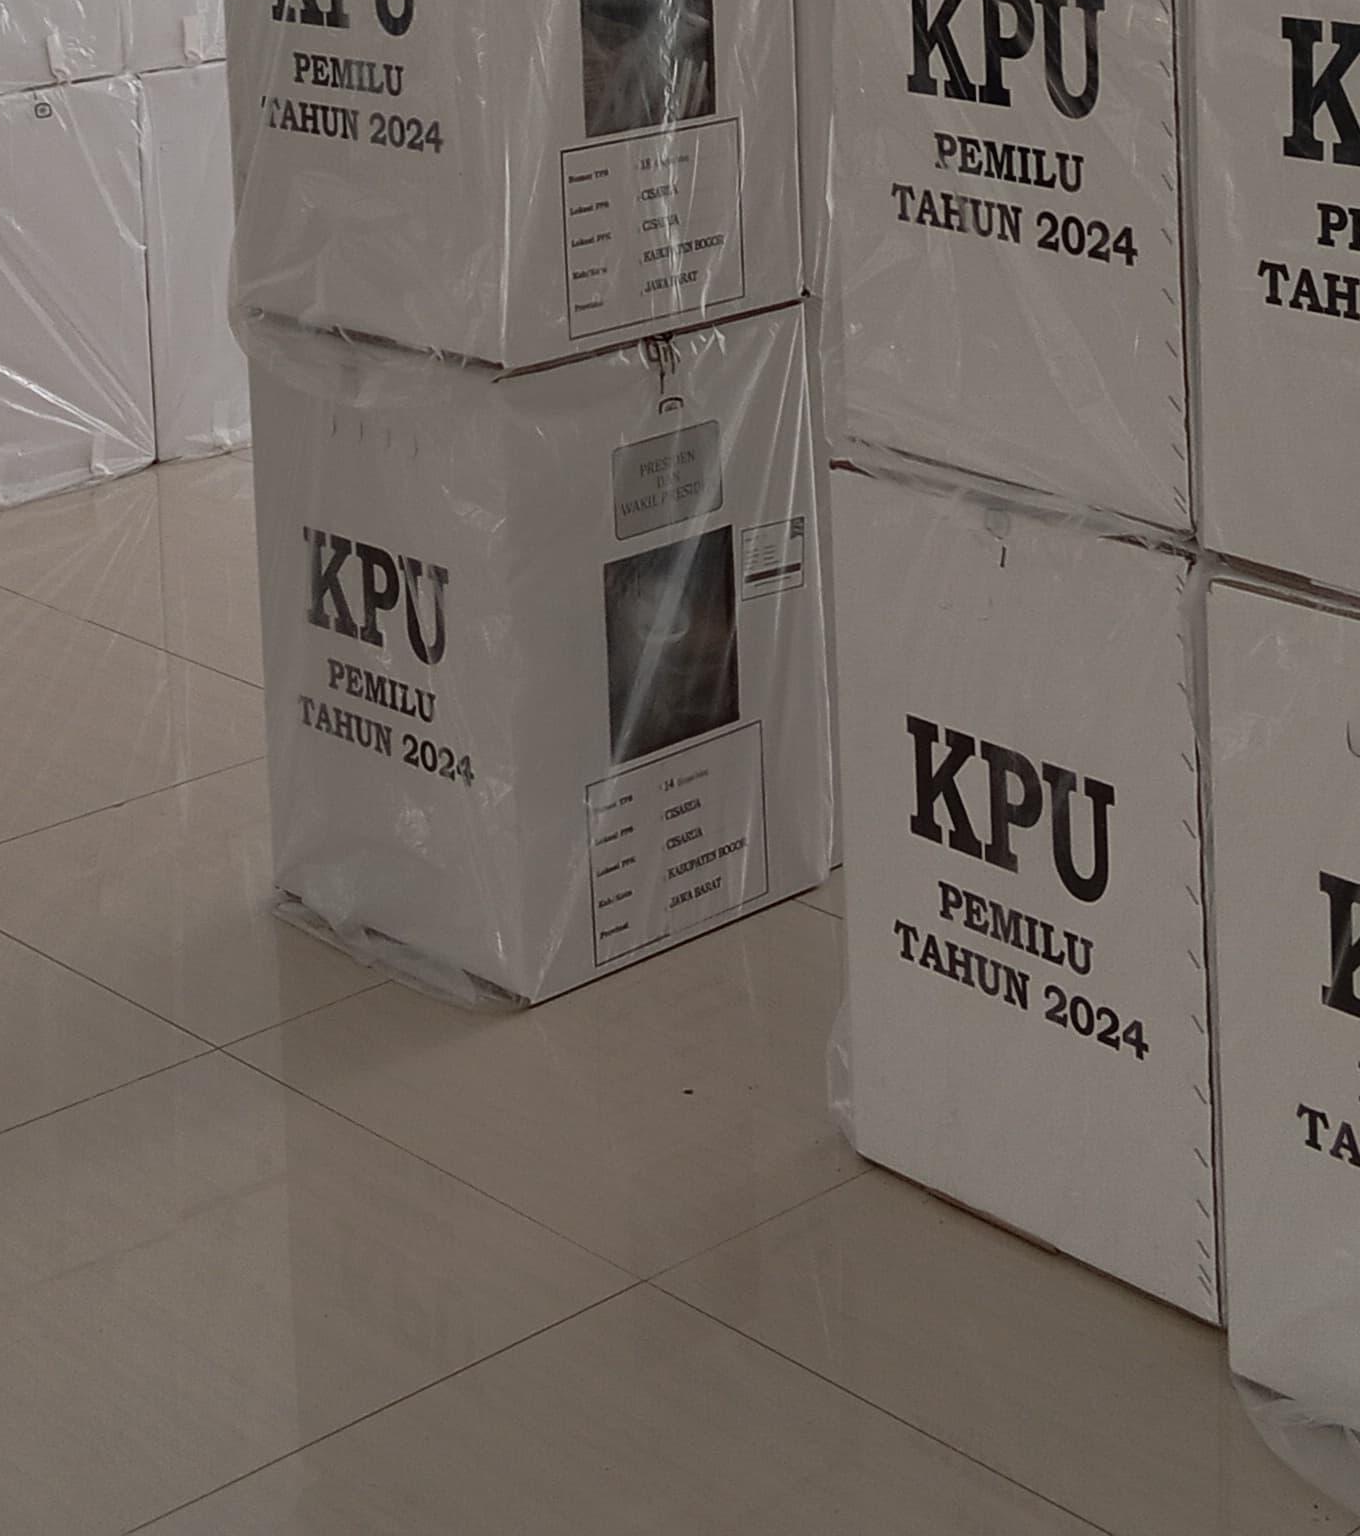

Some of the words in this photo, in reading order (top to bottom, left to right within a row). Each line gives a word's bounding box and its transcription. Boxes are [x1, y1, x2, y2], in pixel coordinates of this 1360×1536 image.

[293, 51, 404, 97] PEMILU
[261, 95, 360, 143] TAHUN
[370, 116, 444, 153] 2024
[933, 131, 1084, 193] PEMILU
[891, 183, 1022, 243] TAHUN
[1036, 212, 1138, 267] 2024
[640, 449, 695, 476] PRESEN
[302, 525, 449, 665] KPU
[327, 659, 437, 723] PEMILU
[299, 695, 393, 757] TAHUN
[401, 734, 475, 787] 2024
[905, 713, 1114, 903] KPU
[938, 879, 1093, 976] PEMILU
[893, 919, 1030, 1012] TAHUN
[1043, 985, 1150, 1061] 2024
